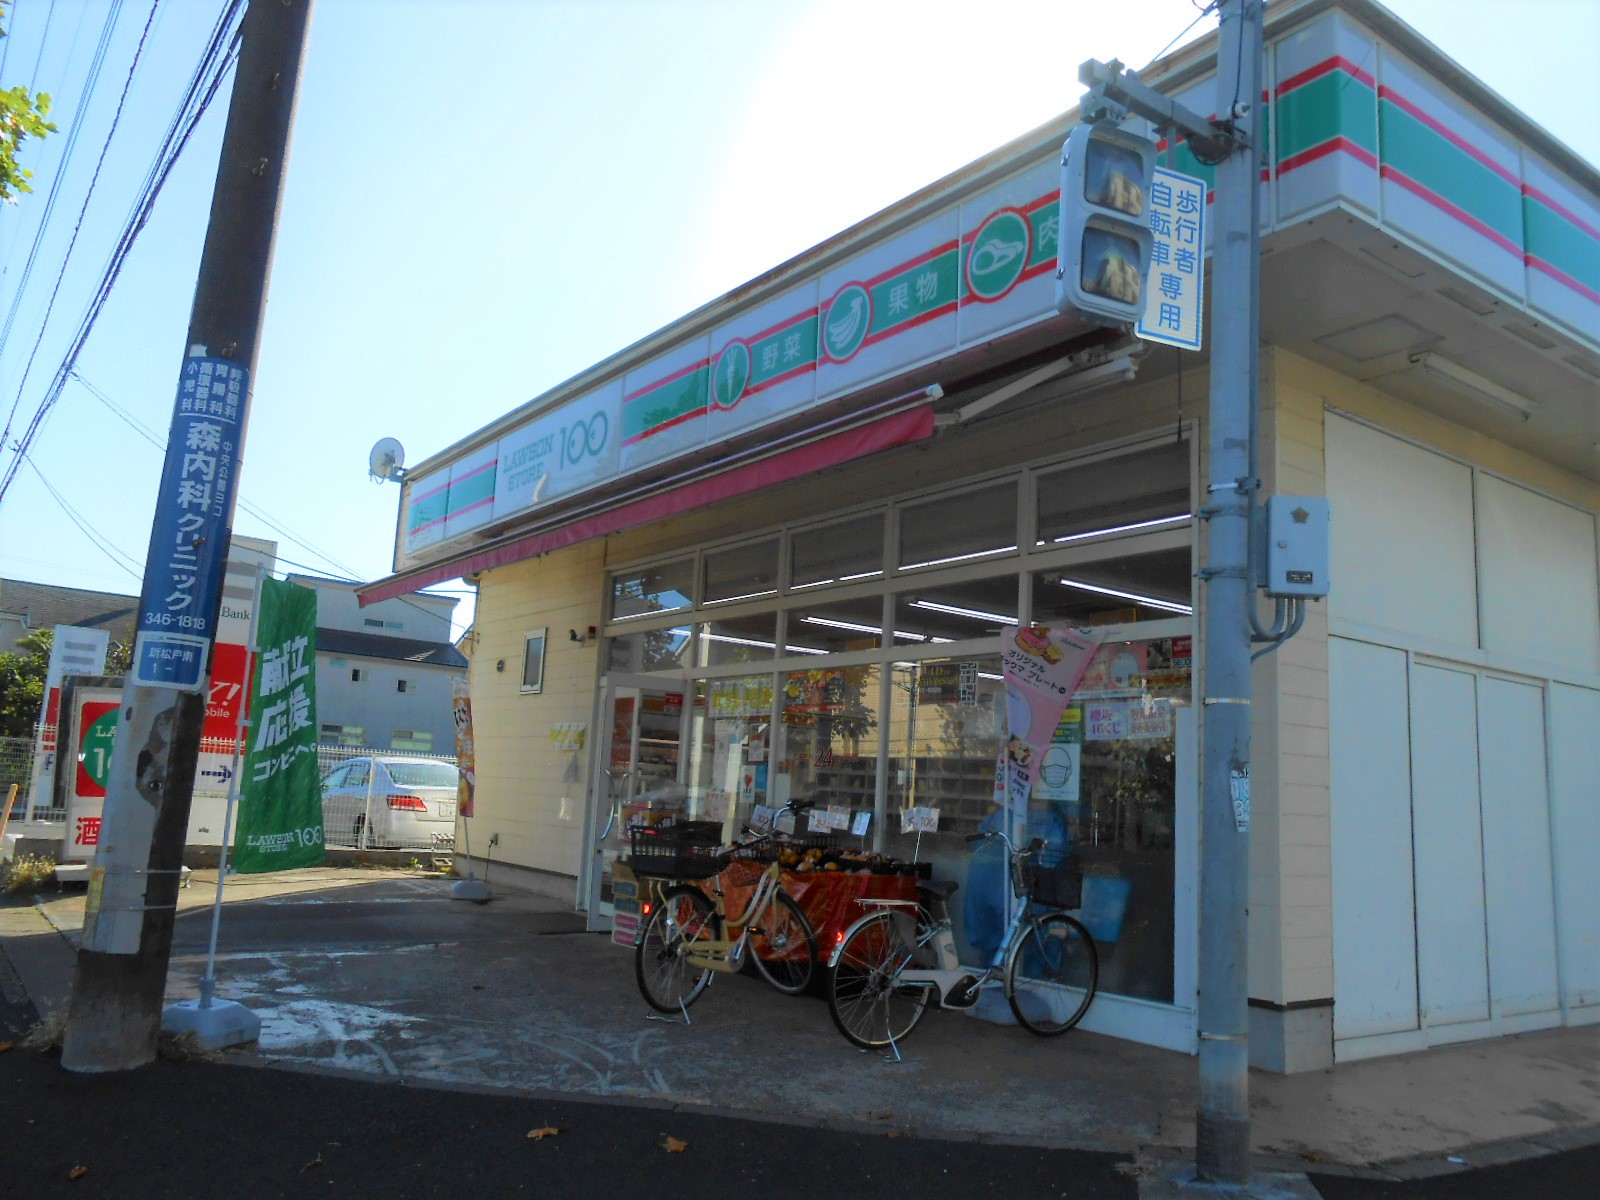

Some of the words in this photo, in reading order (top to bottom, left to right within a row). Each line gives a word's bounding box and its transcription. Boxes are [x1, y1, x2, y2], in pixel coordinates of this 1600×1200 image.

[1039, 215, 1059, 251] 肉
[1150, 181, 1173, 266] 自転車
[1174, 190, 1198, 274] 歩行者
[888, 271, 938, 316] 果物
[1159, 272, 1182, 331] 専用
[762, 335, 801, 371] 野菜
[181, 361, 198, 411] 小児科
[502, 432, 554, 473] LAWSON
[560, 411, 608, 470] 100
[508, 462, 545, 491] STORE
[145, 612, 206, 630] 346-1818
[219, 606, 250, 620] Bank
[260, 635, 309, 697] 献立
[1009, 649, 1045, 673] オリジナル
[205, 708, 230, 718] obile
[253, 683, 313, 752] 応援
[247, 832, 295, 846] LAWSON
